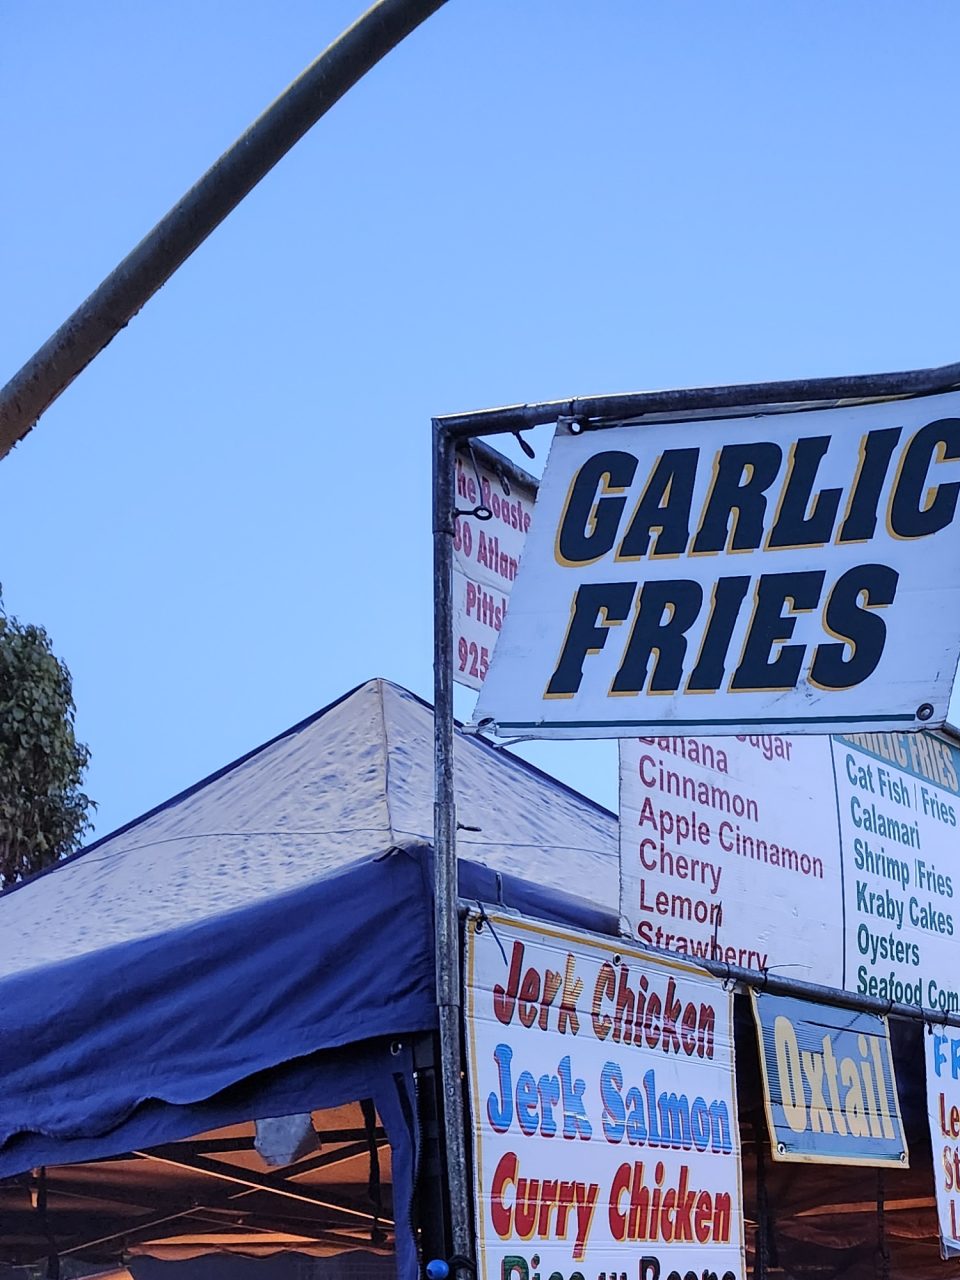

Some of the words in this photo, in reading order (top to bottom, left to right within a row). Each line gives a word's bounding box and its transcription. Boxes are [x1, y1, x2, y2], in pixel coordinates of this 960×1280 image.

[455, 461, 476, 504] he
[477, 530, 521, 582] Atlan
[458, 636, 490, 682] 925
[543, 563, 900, 700] FRIES
[638, 736, 729, 774] anana
[735, 735, 793, 761] ugar
[908, 732, 959, 793] FRIES
[638, 754, 759, 822] Cinnamon
[845, 753, 876, 795] Cat
[877, 766, 911, 808] Fish
[920, 786, 957, 828] Fries
[638, 796, 711, 845] Apple
[718, 820, 824, 879] Cinnamon
[850, 795, 921, 850] Calamari
[638, 837, 722, 895] Cherry
[853, 837, 910, 891] Shrimp
[917, 860, 954, 899] Fries
[639, 878, 723, 927] Lemon
[856, 879, 904, 931] Kraby
[909, 896, 955, 936] Cakes
[857, 922, 920, 966] Oysters
[493, 940, 585, 1037] Jerk
[591, 959, 716, 1060] Chicken
[856, 965, 923, 1008] Seafood
[487, 1043, 593, 1141] Jerk
[600, 1061, 733, 1155] Salmon
[773, 1014, 897, 1140] Oxtail
[490, 1152, 600, 1262] Curry
[608, 1159, 732, 1245] Chicken
